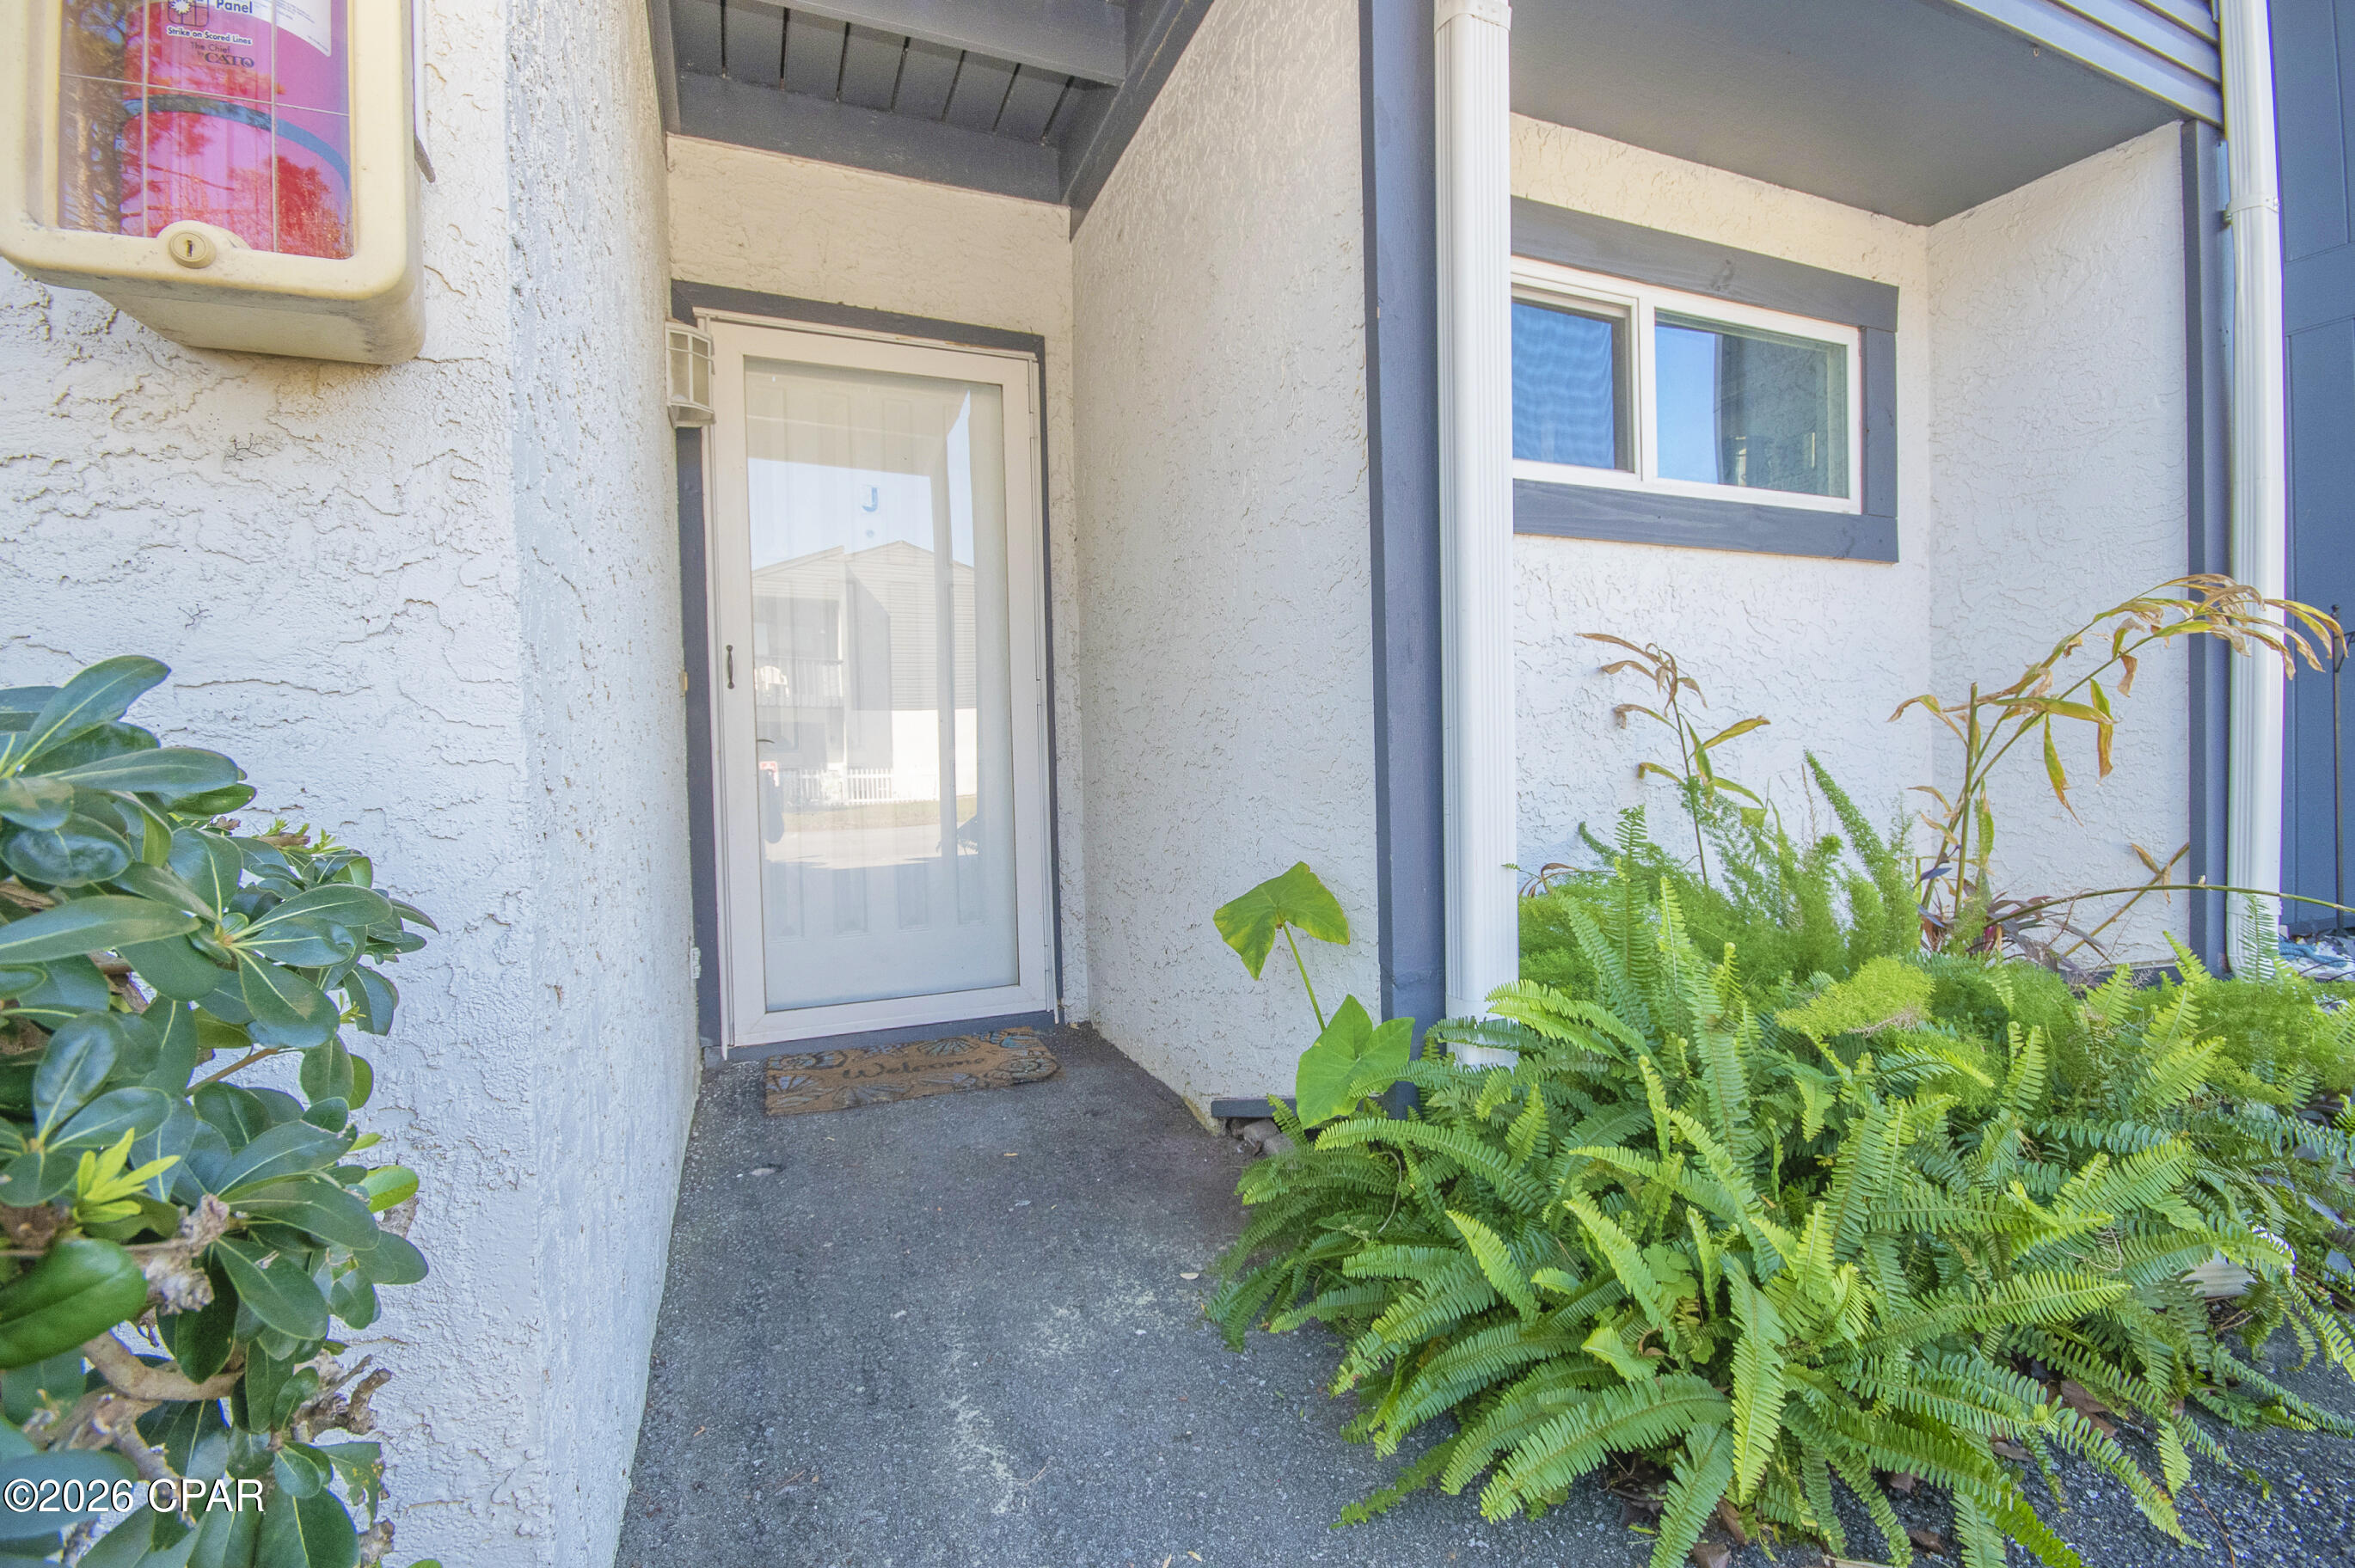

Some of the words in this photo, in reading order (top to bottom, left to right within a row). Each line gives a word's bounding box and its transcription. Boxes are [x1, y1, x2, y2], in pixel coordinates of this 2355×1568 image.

[216, 0, 253, 14] Panel
[167, 27, 191, 37] Strike
[205, 32, 230, 42] Scored
[232, 34, 252, 45] Lines
[190, 41, 205, 50] The
[208, 43, 231, 53] Chief
[204, 52, 255, 68] CATO
[842, 1057, 984, 1080] Welcome
